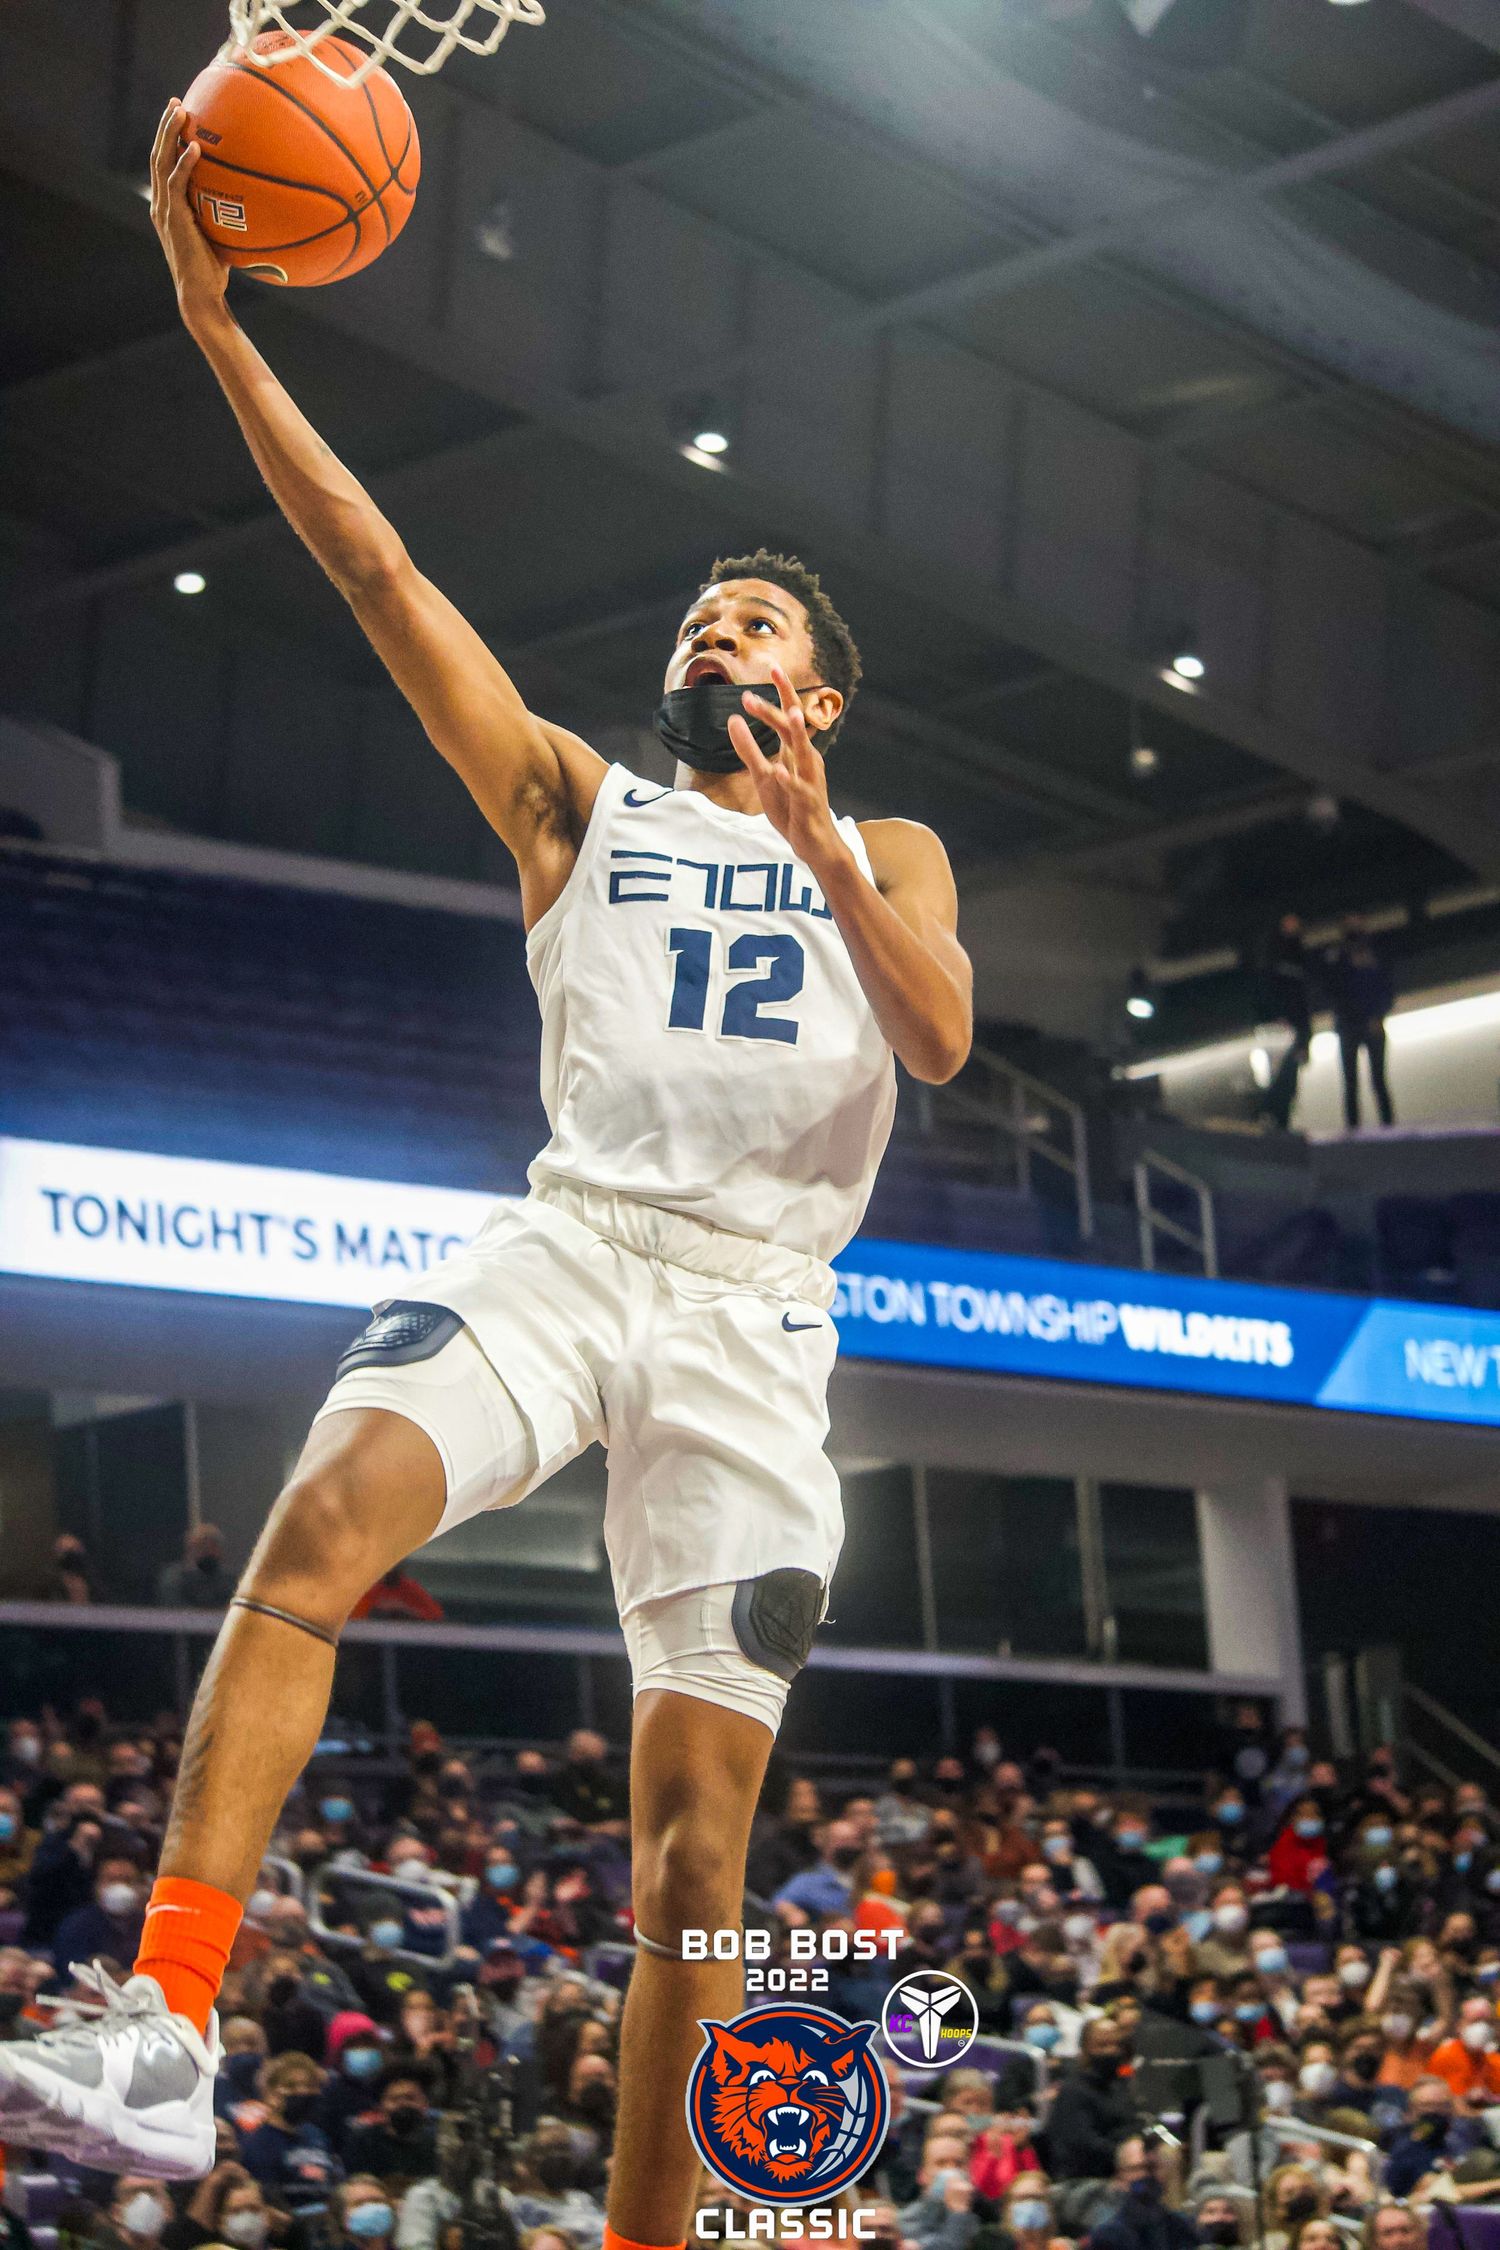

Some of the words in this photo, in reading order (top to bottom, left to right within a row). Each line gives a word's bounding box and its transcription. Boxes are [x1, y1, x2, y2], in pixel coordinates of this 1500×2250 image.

[668, 927, 805, 1045] 12
[40, 1186, 318, 1262] TONIGHT'S
[336, 1222, 463, 1272] MATC
[832, 1271, 927, 1327] STON
[927, 1280, 1119, 1346] TOWNSHIP
[1118, 1302, 1295, 1368] WILDKITS
